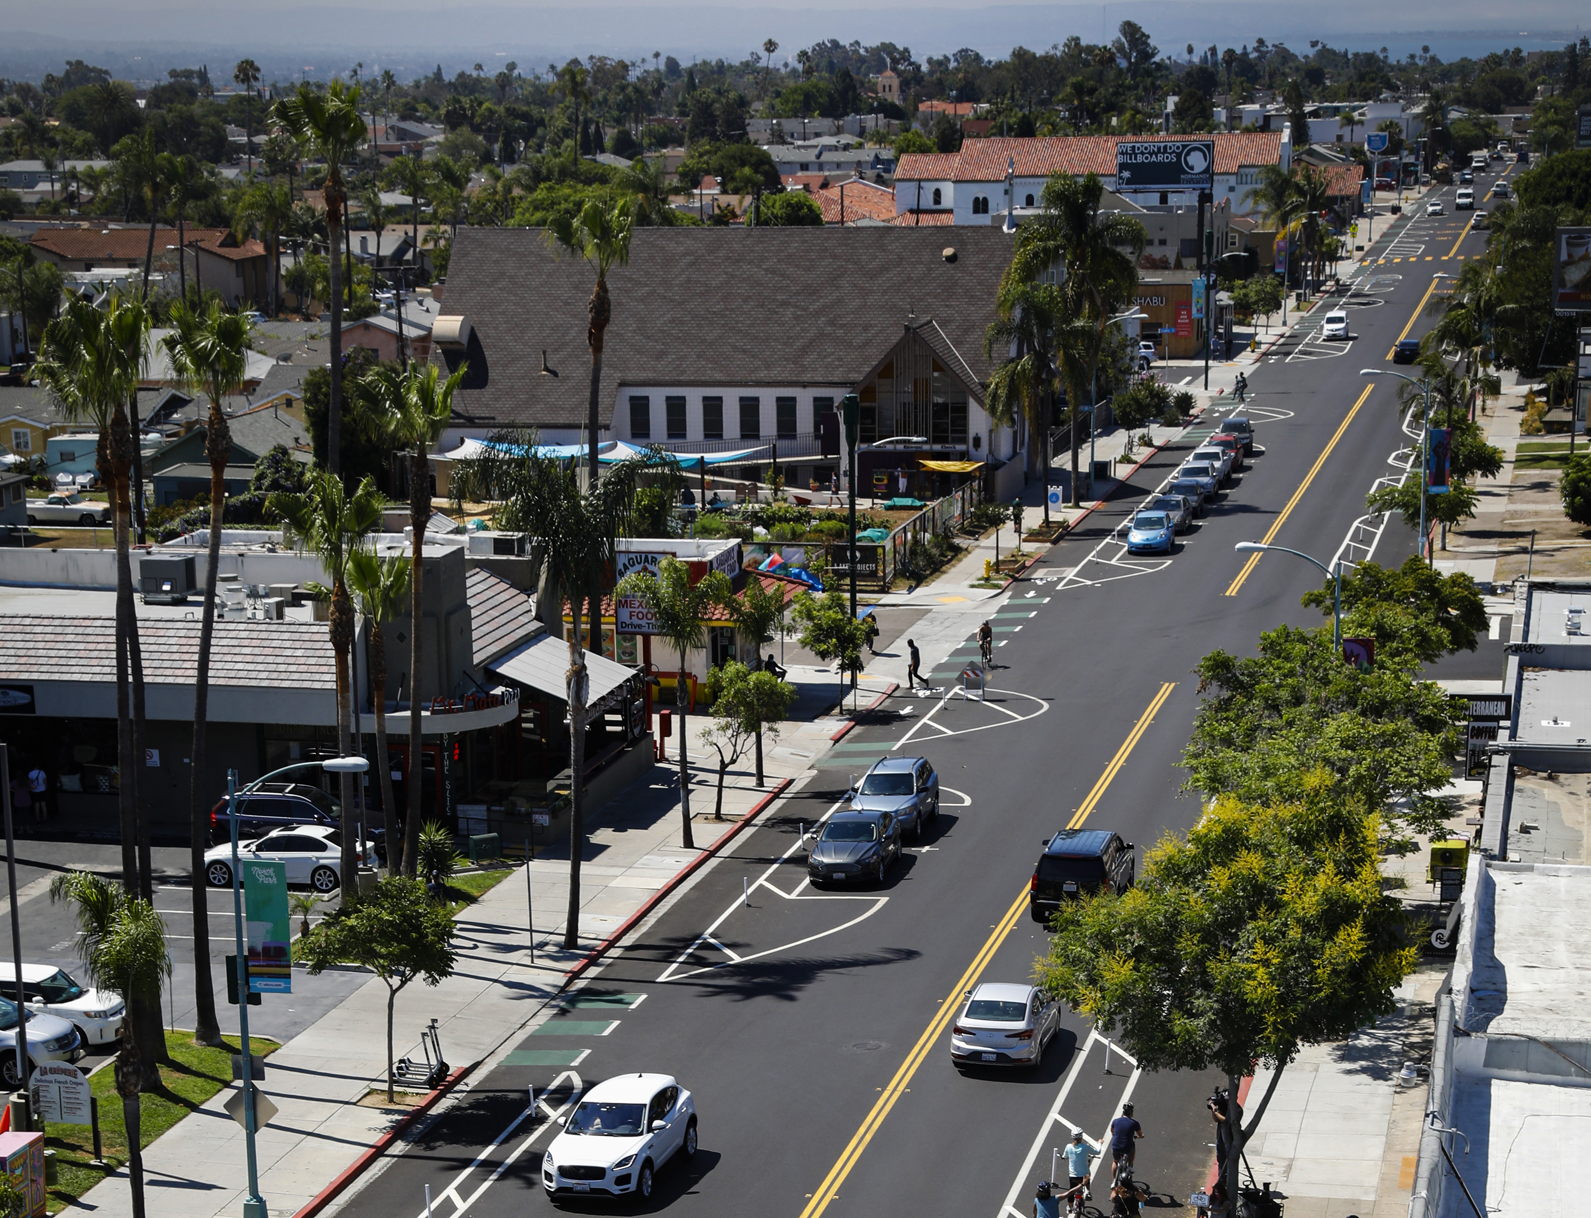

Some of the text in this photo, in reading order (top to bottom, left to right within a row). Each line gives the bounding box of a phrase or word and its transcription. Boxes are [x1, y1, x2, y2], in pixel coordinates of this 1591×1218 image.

[1119, 144, 1182, 153] WE DON'T DO
[1118, 154, 1176, 163] BILLBOARDS
[430, 696, 458, 715] Mr.
[463, 692, 500, 712] Moto
[1470, 726, 1496, 740] COFFEE
[40, 1066, 48, 1076] LA
